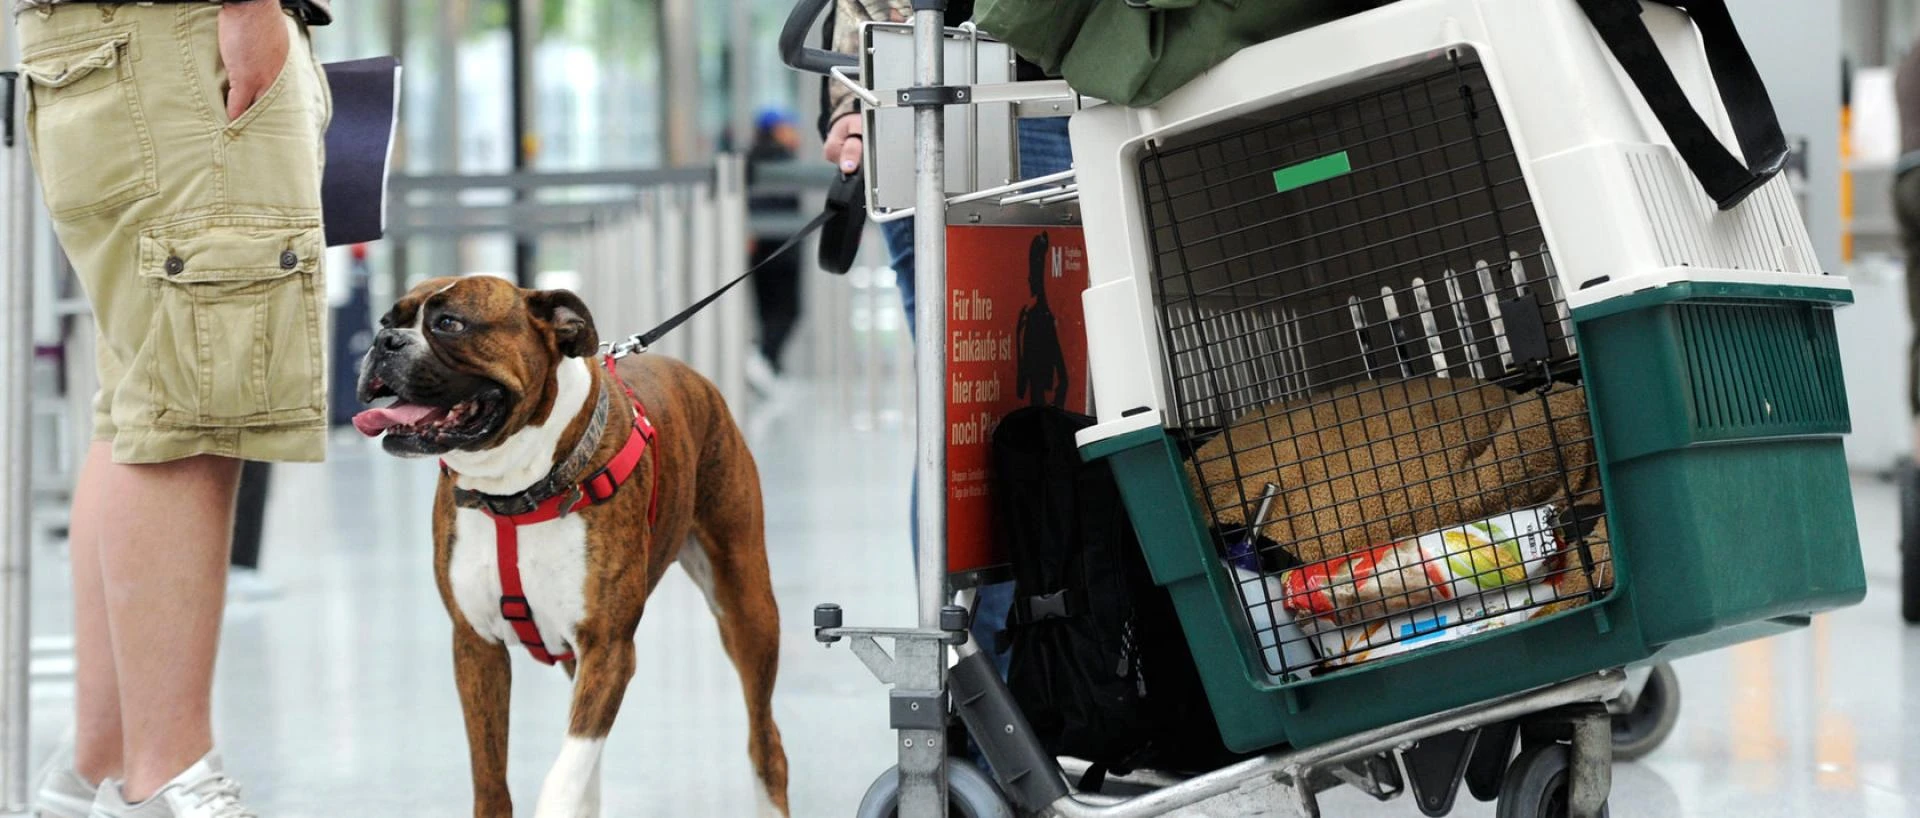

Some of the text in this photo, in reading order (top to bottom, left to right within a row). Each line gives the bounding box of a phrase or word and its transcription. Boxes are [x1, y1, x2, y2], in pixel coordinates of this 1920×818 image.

[953, 289, 992, 320] Für Ihre
[953, 331, 1011, 362] Einkäufe ist
[952, 371, 1000, 404] hier auch
[952, 413, 977, 446] noch
